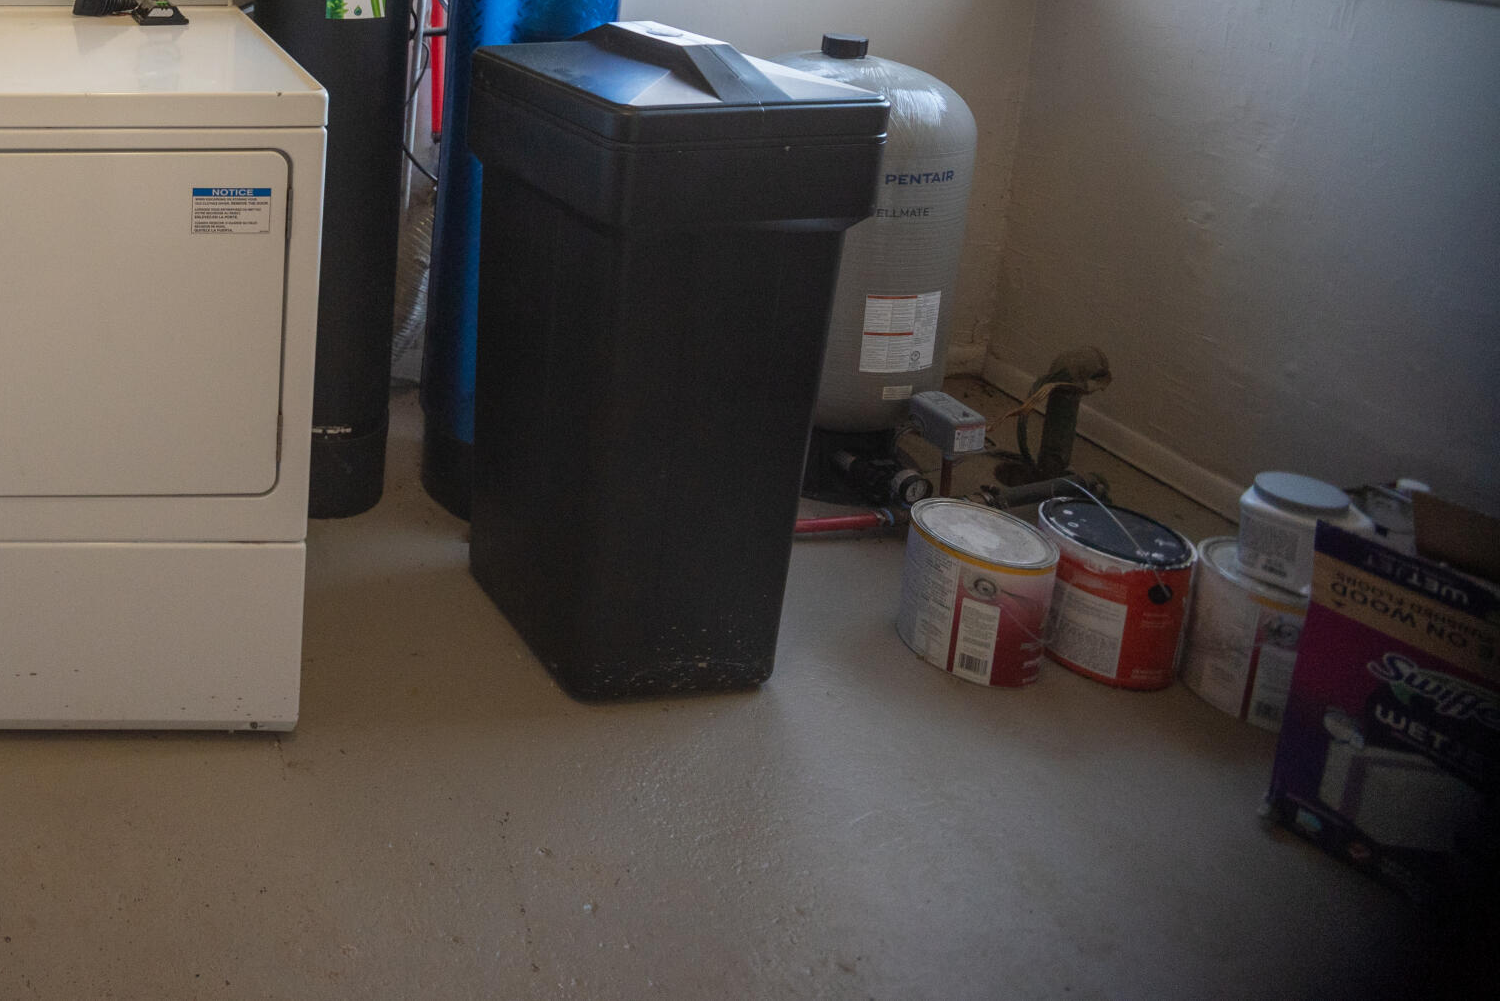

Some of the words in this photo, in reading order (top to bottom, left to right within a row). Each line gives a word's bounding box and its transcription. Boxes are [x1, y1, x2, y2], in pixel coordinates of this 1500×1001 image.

[885, 170, 955, 185] PENTAIR
[212, 188, 254, 196] NOTICE
[876, 207, 930, 218] ELLMATE
[1331, 581, 1417, 628] WOOD
[1427, 622, 1467, 648] ON
[1367, 651, 1500, 731] Swiff
